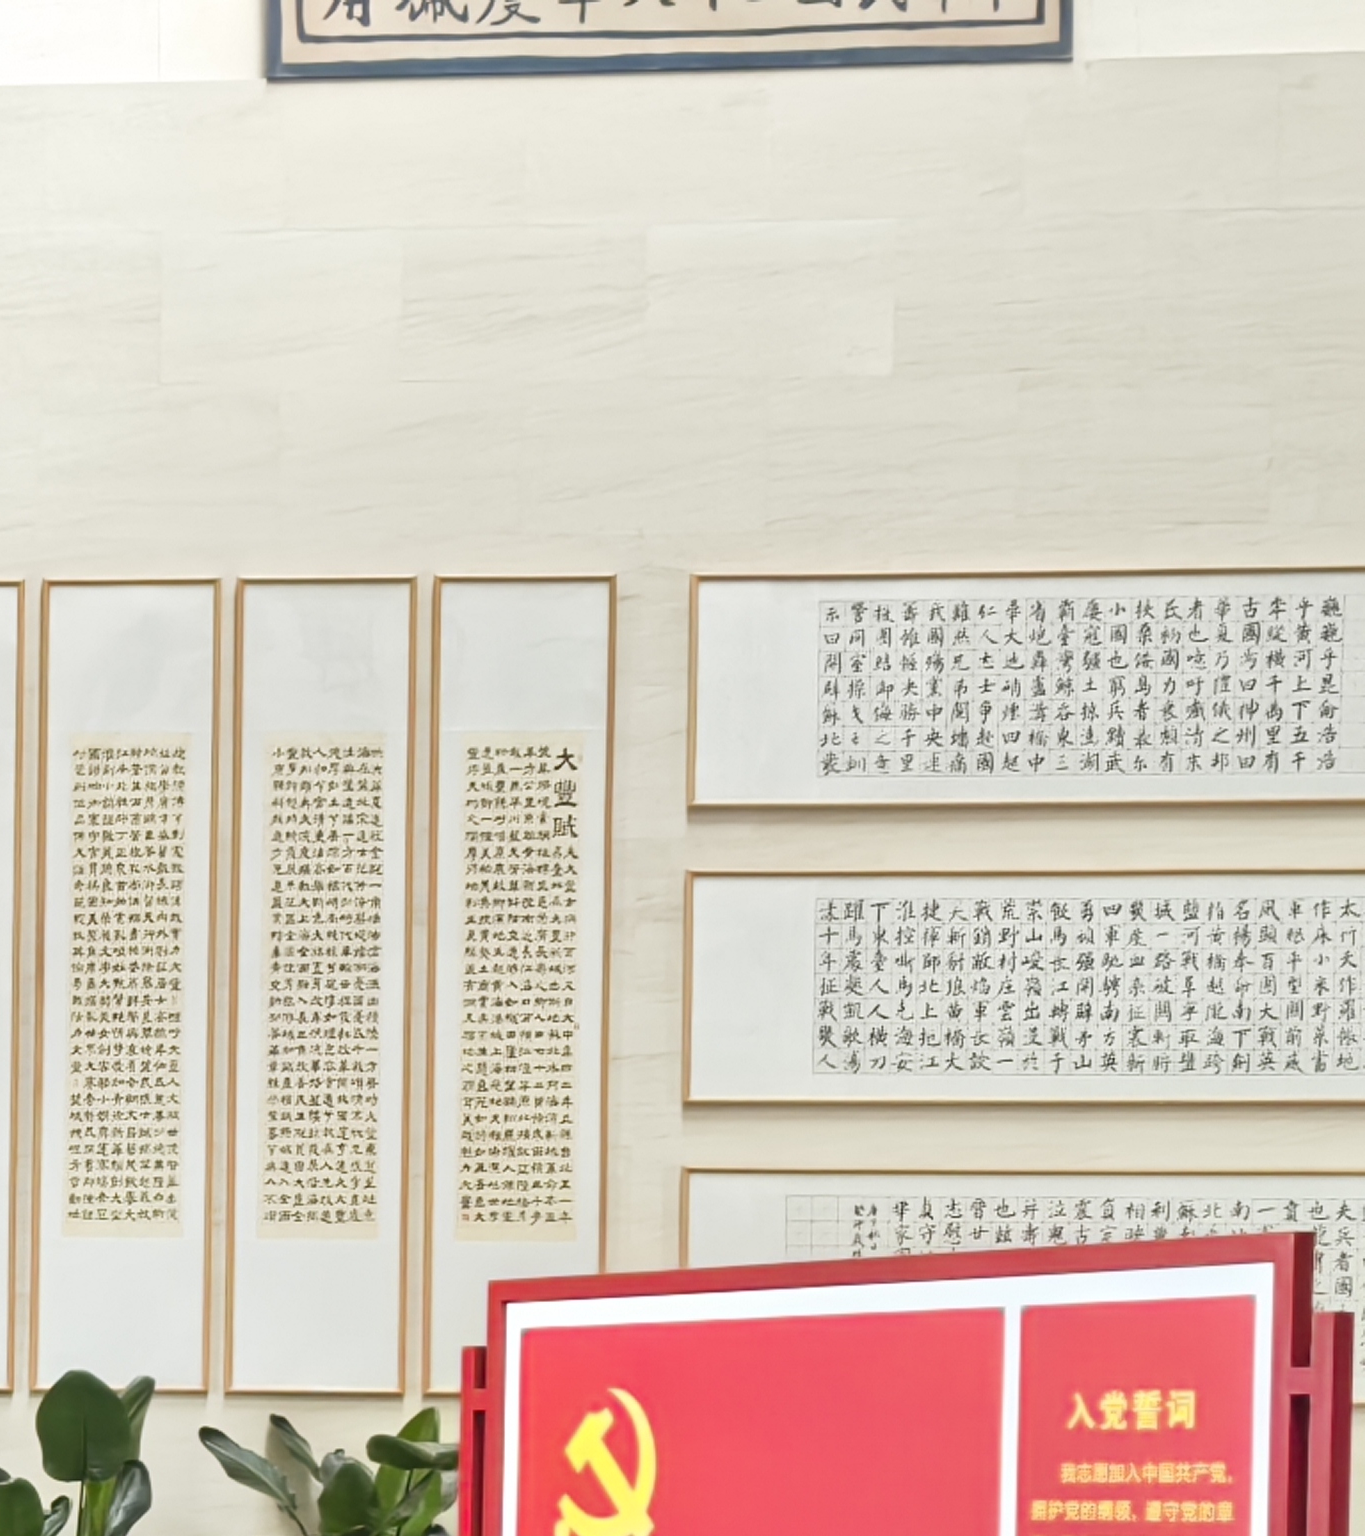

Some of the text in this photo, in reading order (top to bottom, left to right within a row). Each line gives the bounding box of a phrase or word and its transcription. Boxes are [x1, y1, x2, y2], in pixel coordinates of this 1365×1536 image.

[552, 747, 579, 838] 大豐賦
[1334, 1199, 1357, 1312] 夫兵者國
[1067, 1389, 1198, 1431] 入党誓词
